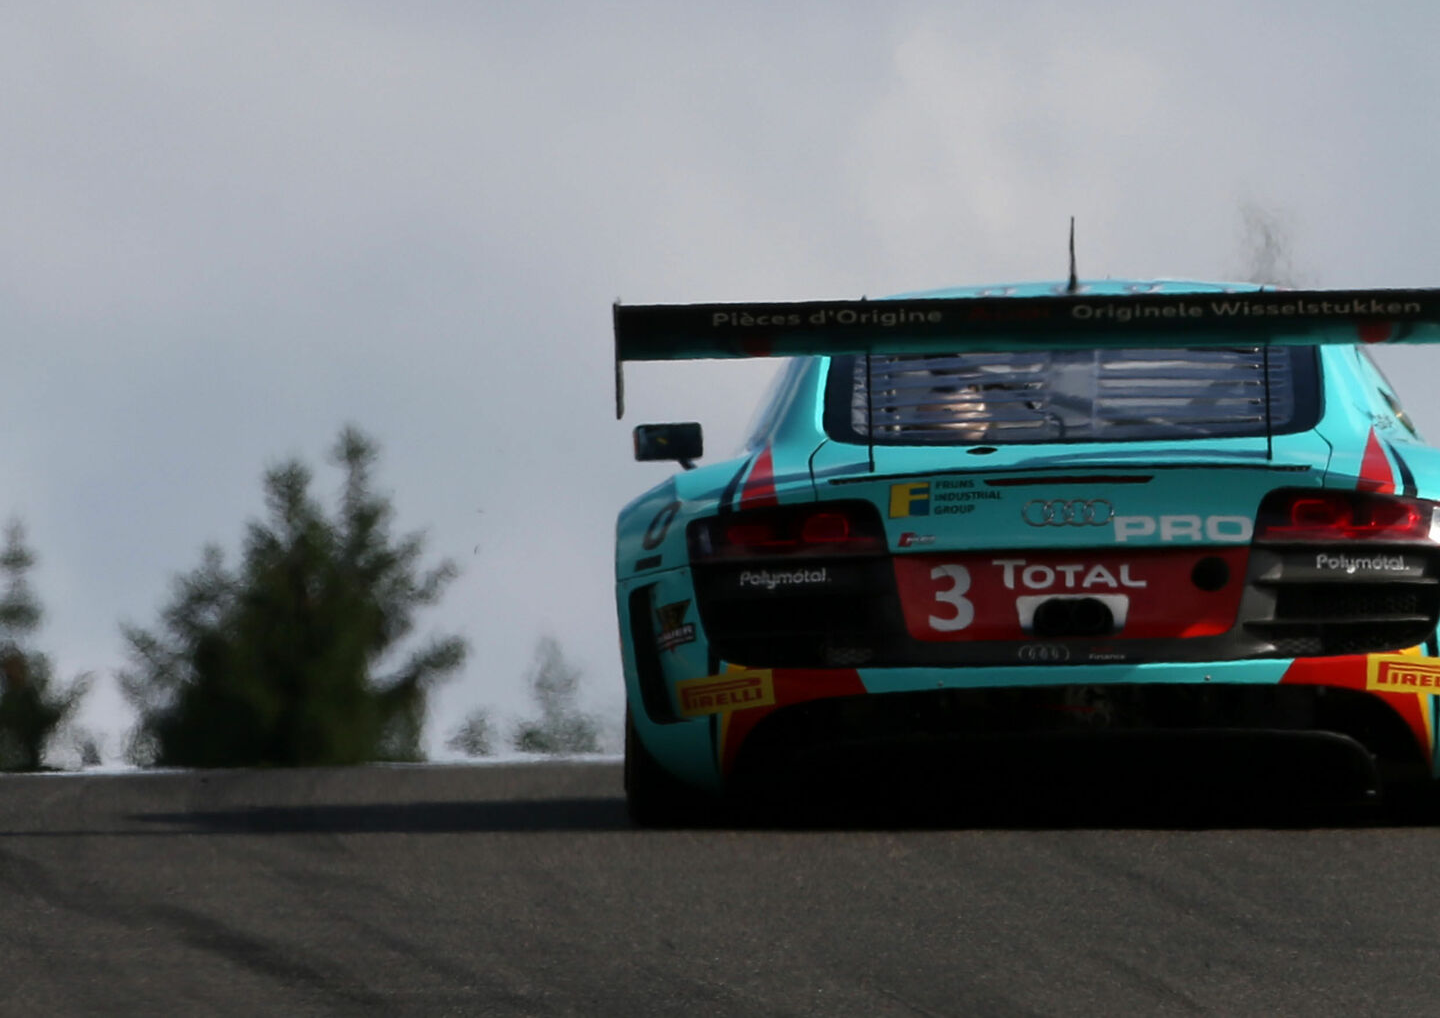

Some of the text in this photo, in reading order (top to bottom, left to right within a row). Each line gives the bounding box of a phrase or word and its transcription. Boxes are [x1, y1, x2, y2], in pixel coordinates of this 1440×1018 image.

[712, 308, 942, 327] Pièces d'Origine
[1071, 299, 1422, 323] Originele Wisselstukken
[934, 491, 1002, 501] INDUSTRIAL
[934, 504, 975, 515] GROUP
[1114, 515, 1253, 542] PRO
[928, 563, 975, 633] 3
[681, 676, 763, 712] PIRELLI
